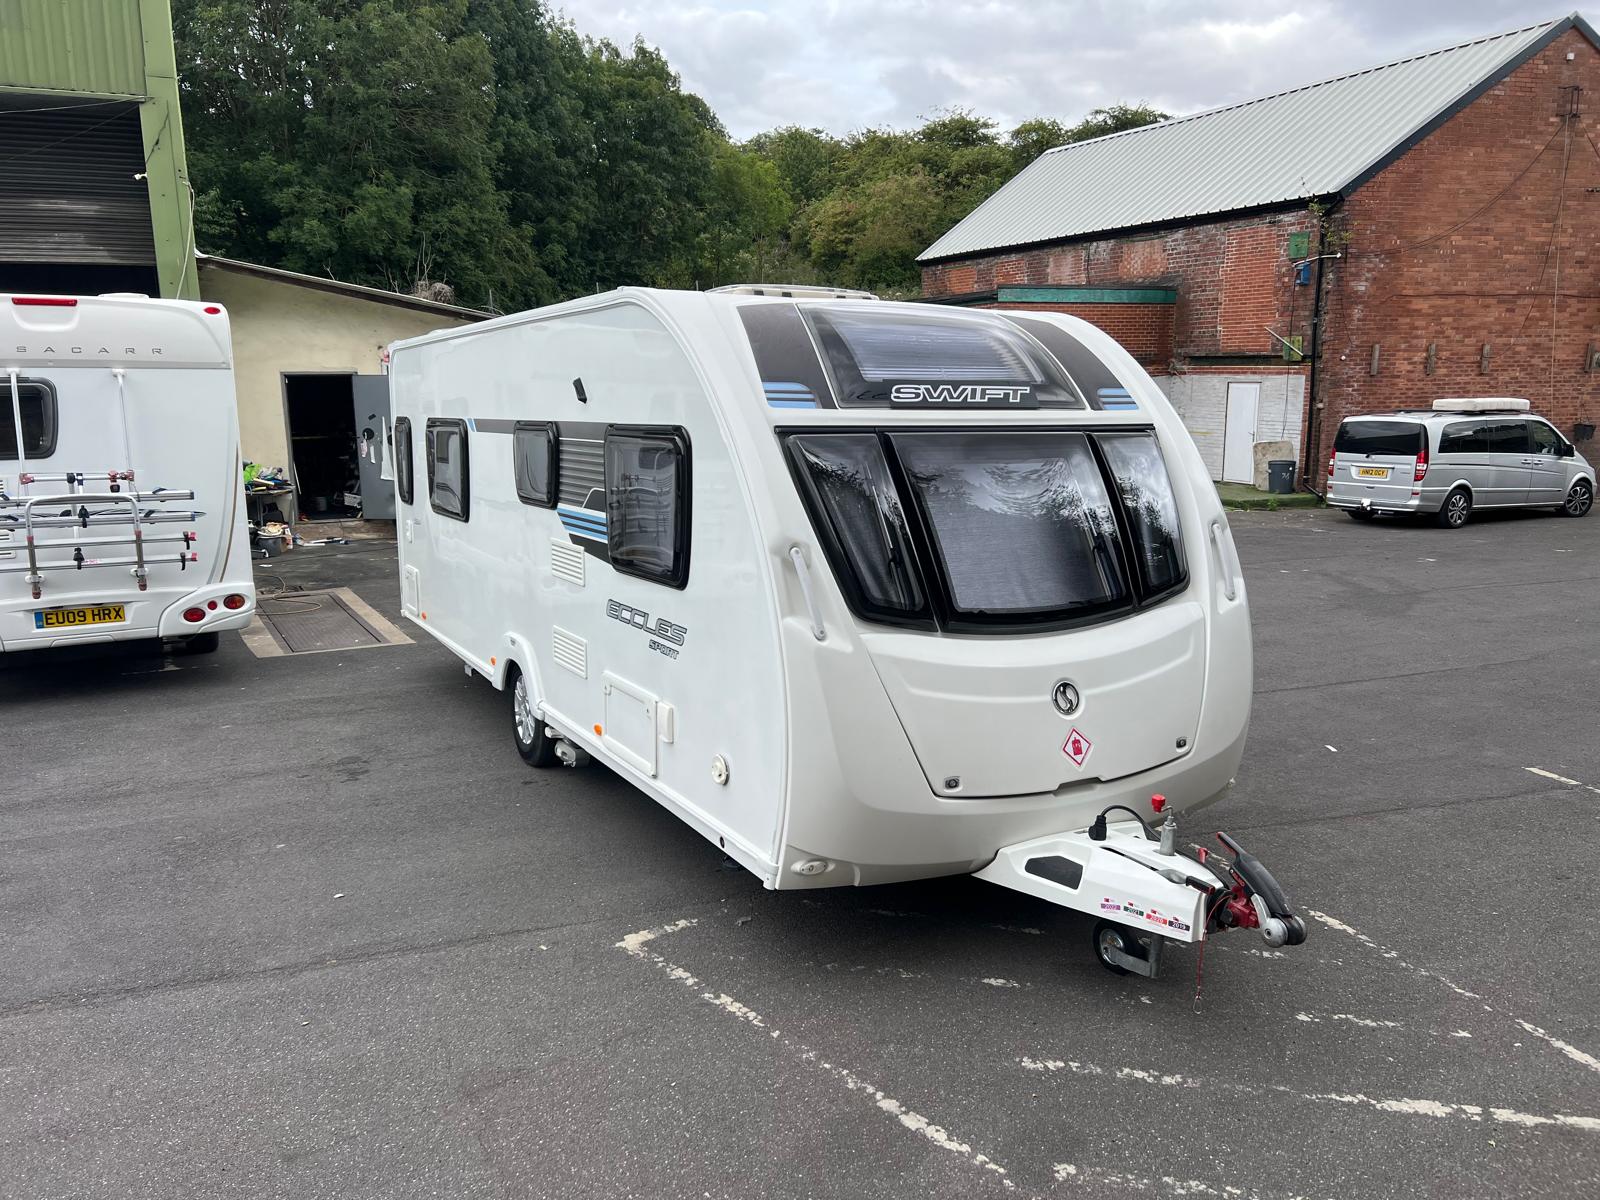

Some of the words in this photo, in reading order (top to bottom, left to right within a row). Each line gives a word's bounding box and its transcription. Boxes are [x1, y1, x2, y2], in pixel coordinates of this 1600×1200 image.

[891, 385, 1030, 403] SWIFT
[44, 610, 86, 626] EU09
[91, 607, 123, 622] HRX
[606, 599, 687, 646] ECCLES
[649, 639, 679, 660] SPORT
